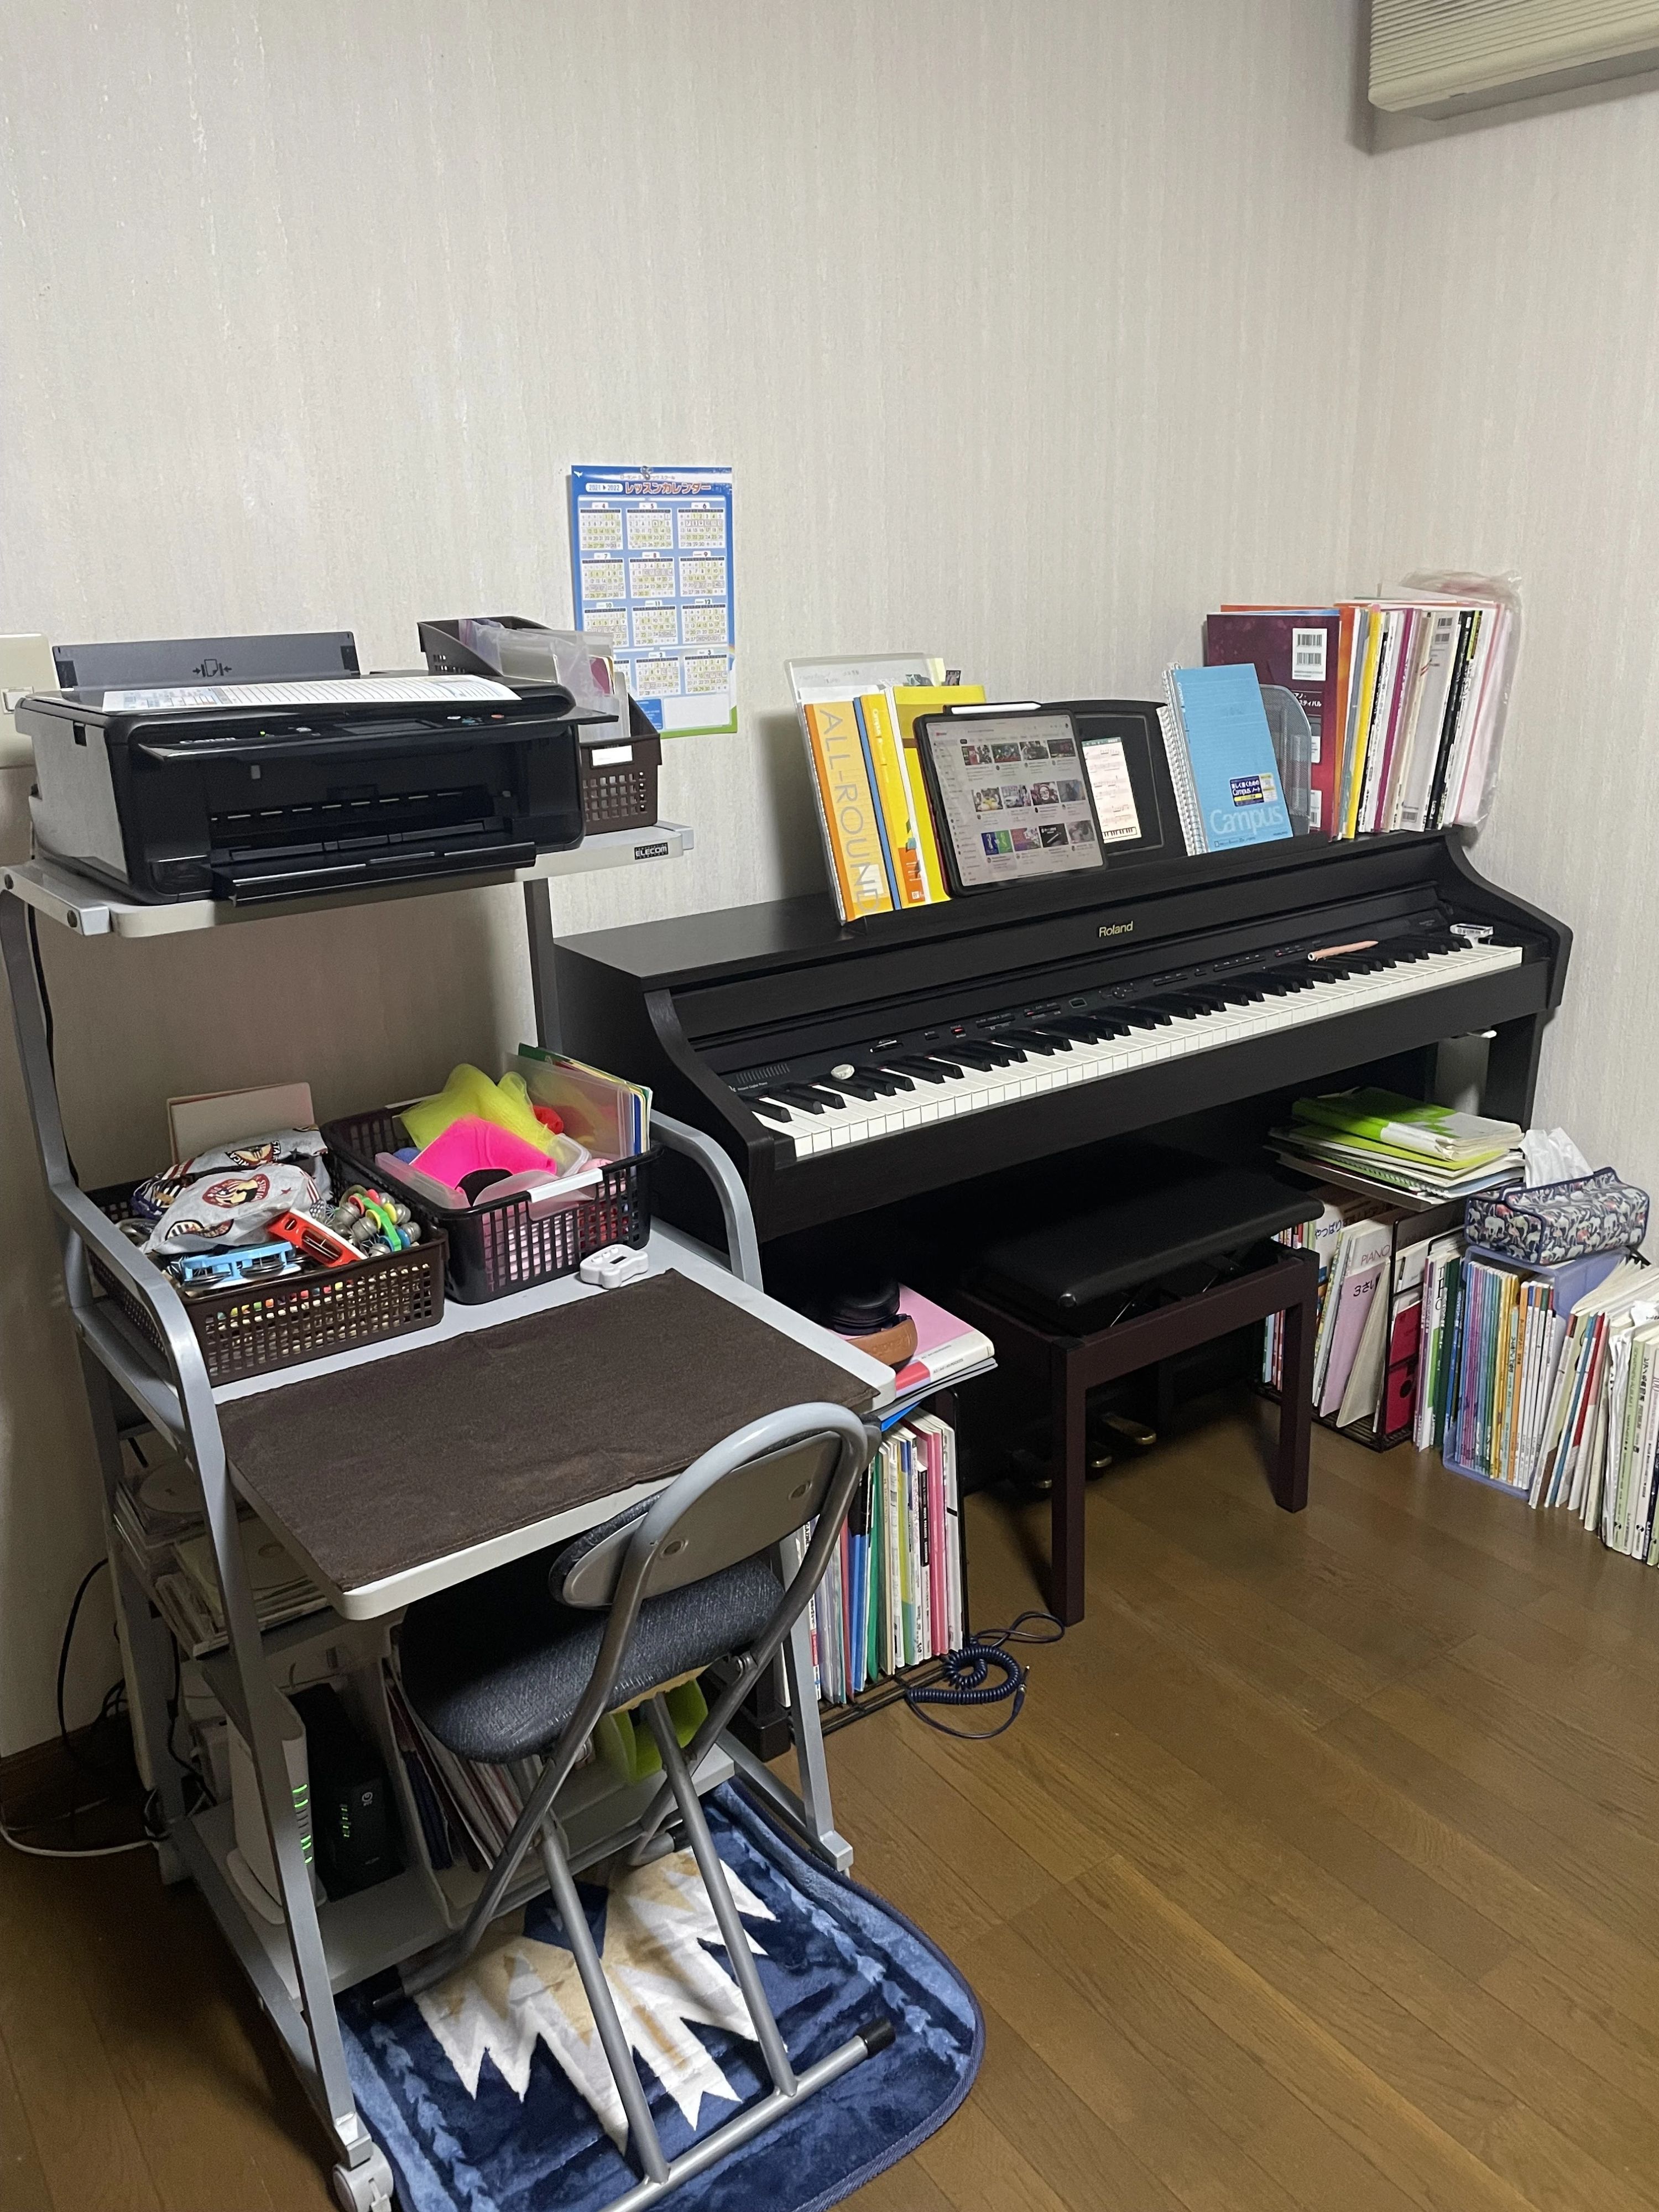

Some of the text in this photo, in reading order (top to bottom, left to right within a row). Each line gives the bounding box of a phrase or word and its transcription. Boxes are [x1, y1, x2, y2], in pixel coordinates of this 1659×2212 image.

[625, 482, 711, 494] レッスンカレンダー
[819, 708, 880, 914] ALL-ROUND
[1211, 806, 1283, 835] Campus
[635, 846, 667, 857] ELECOM
[1099, 920, 1134, 938] Roland
[1360, 1244, 1390, 1266] PIANO
